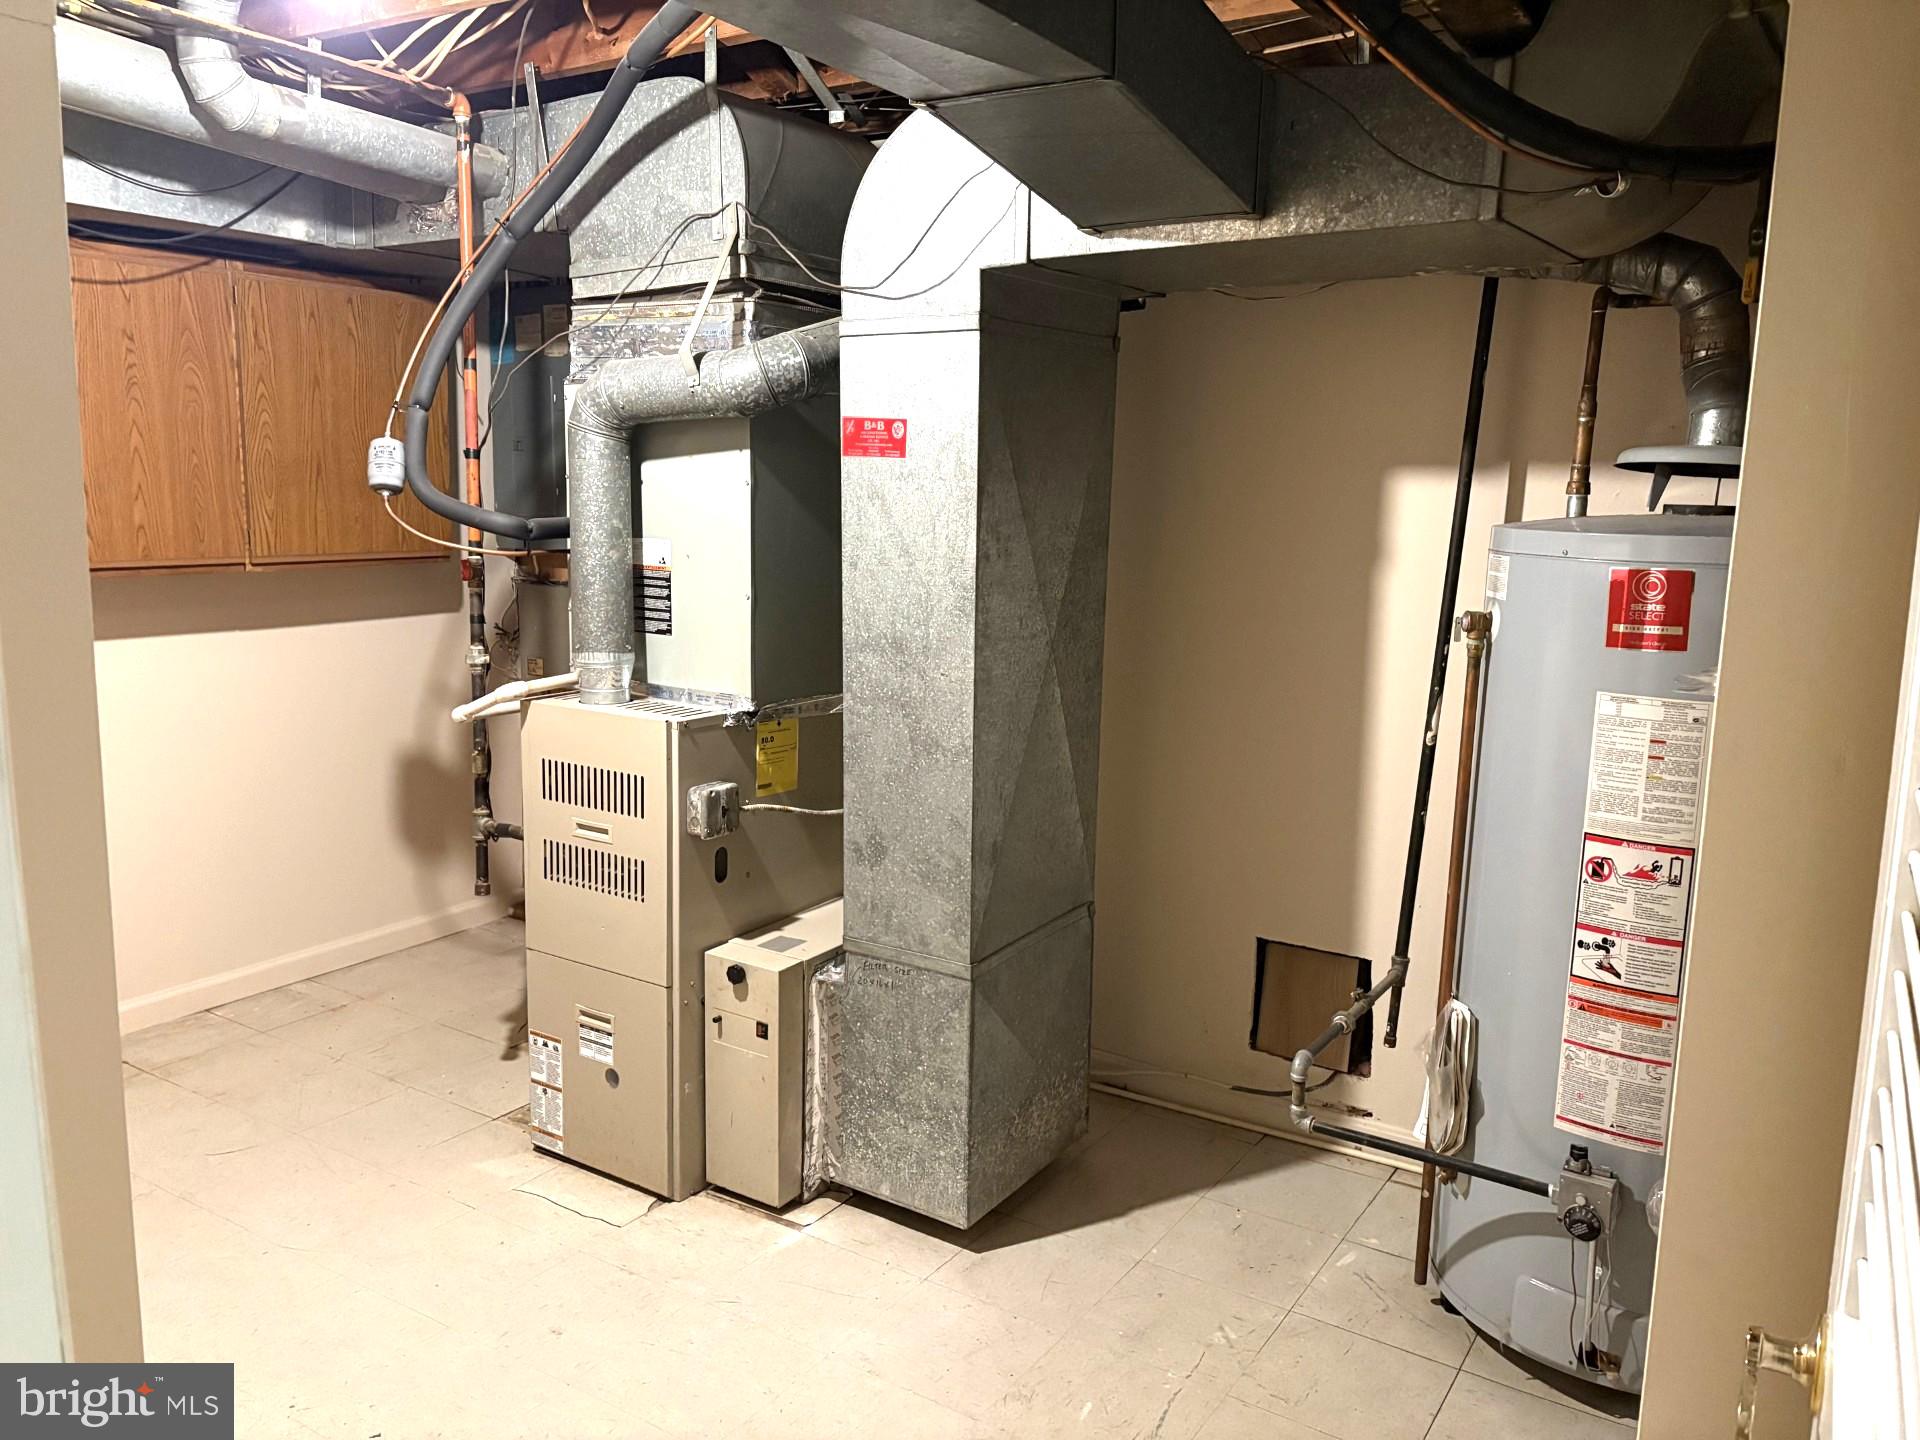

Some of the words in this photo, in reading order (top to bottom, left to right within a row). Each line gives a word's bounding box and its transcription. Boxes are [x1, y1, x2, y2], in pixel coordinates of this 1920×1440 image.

[864, 420, 885, 430] B&B
[1630, 603, 1666, 611] state
[1629, 612, 1664, 621] SELECT
